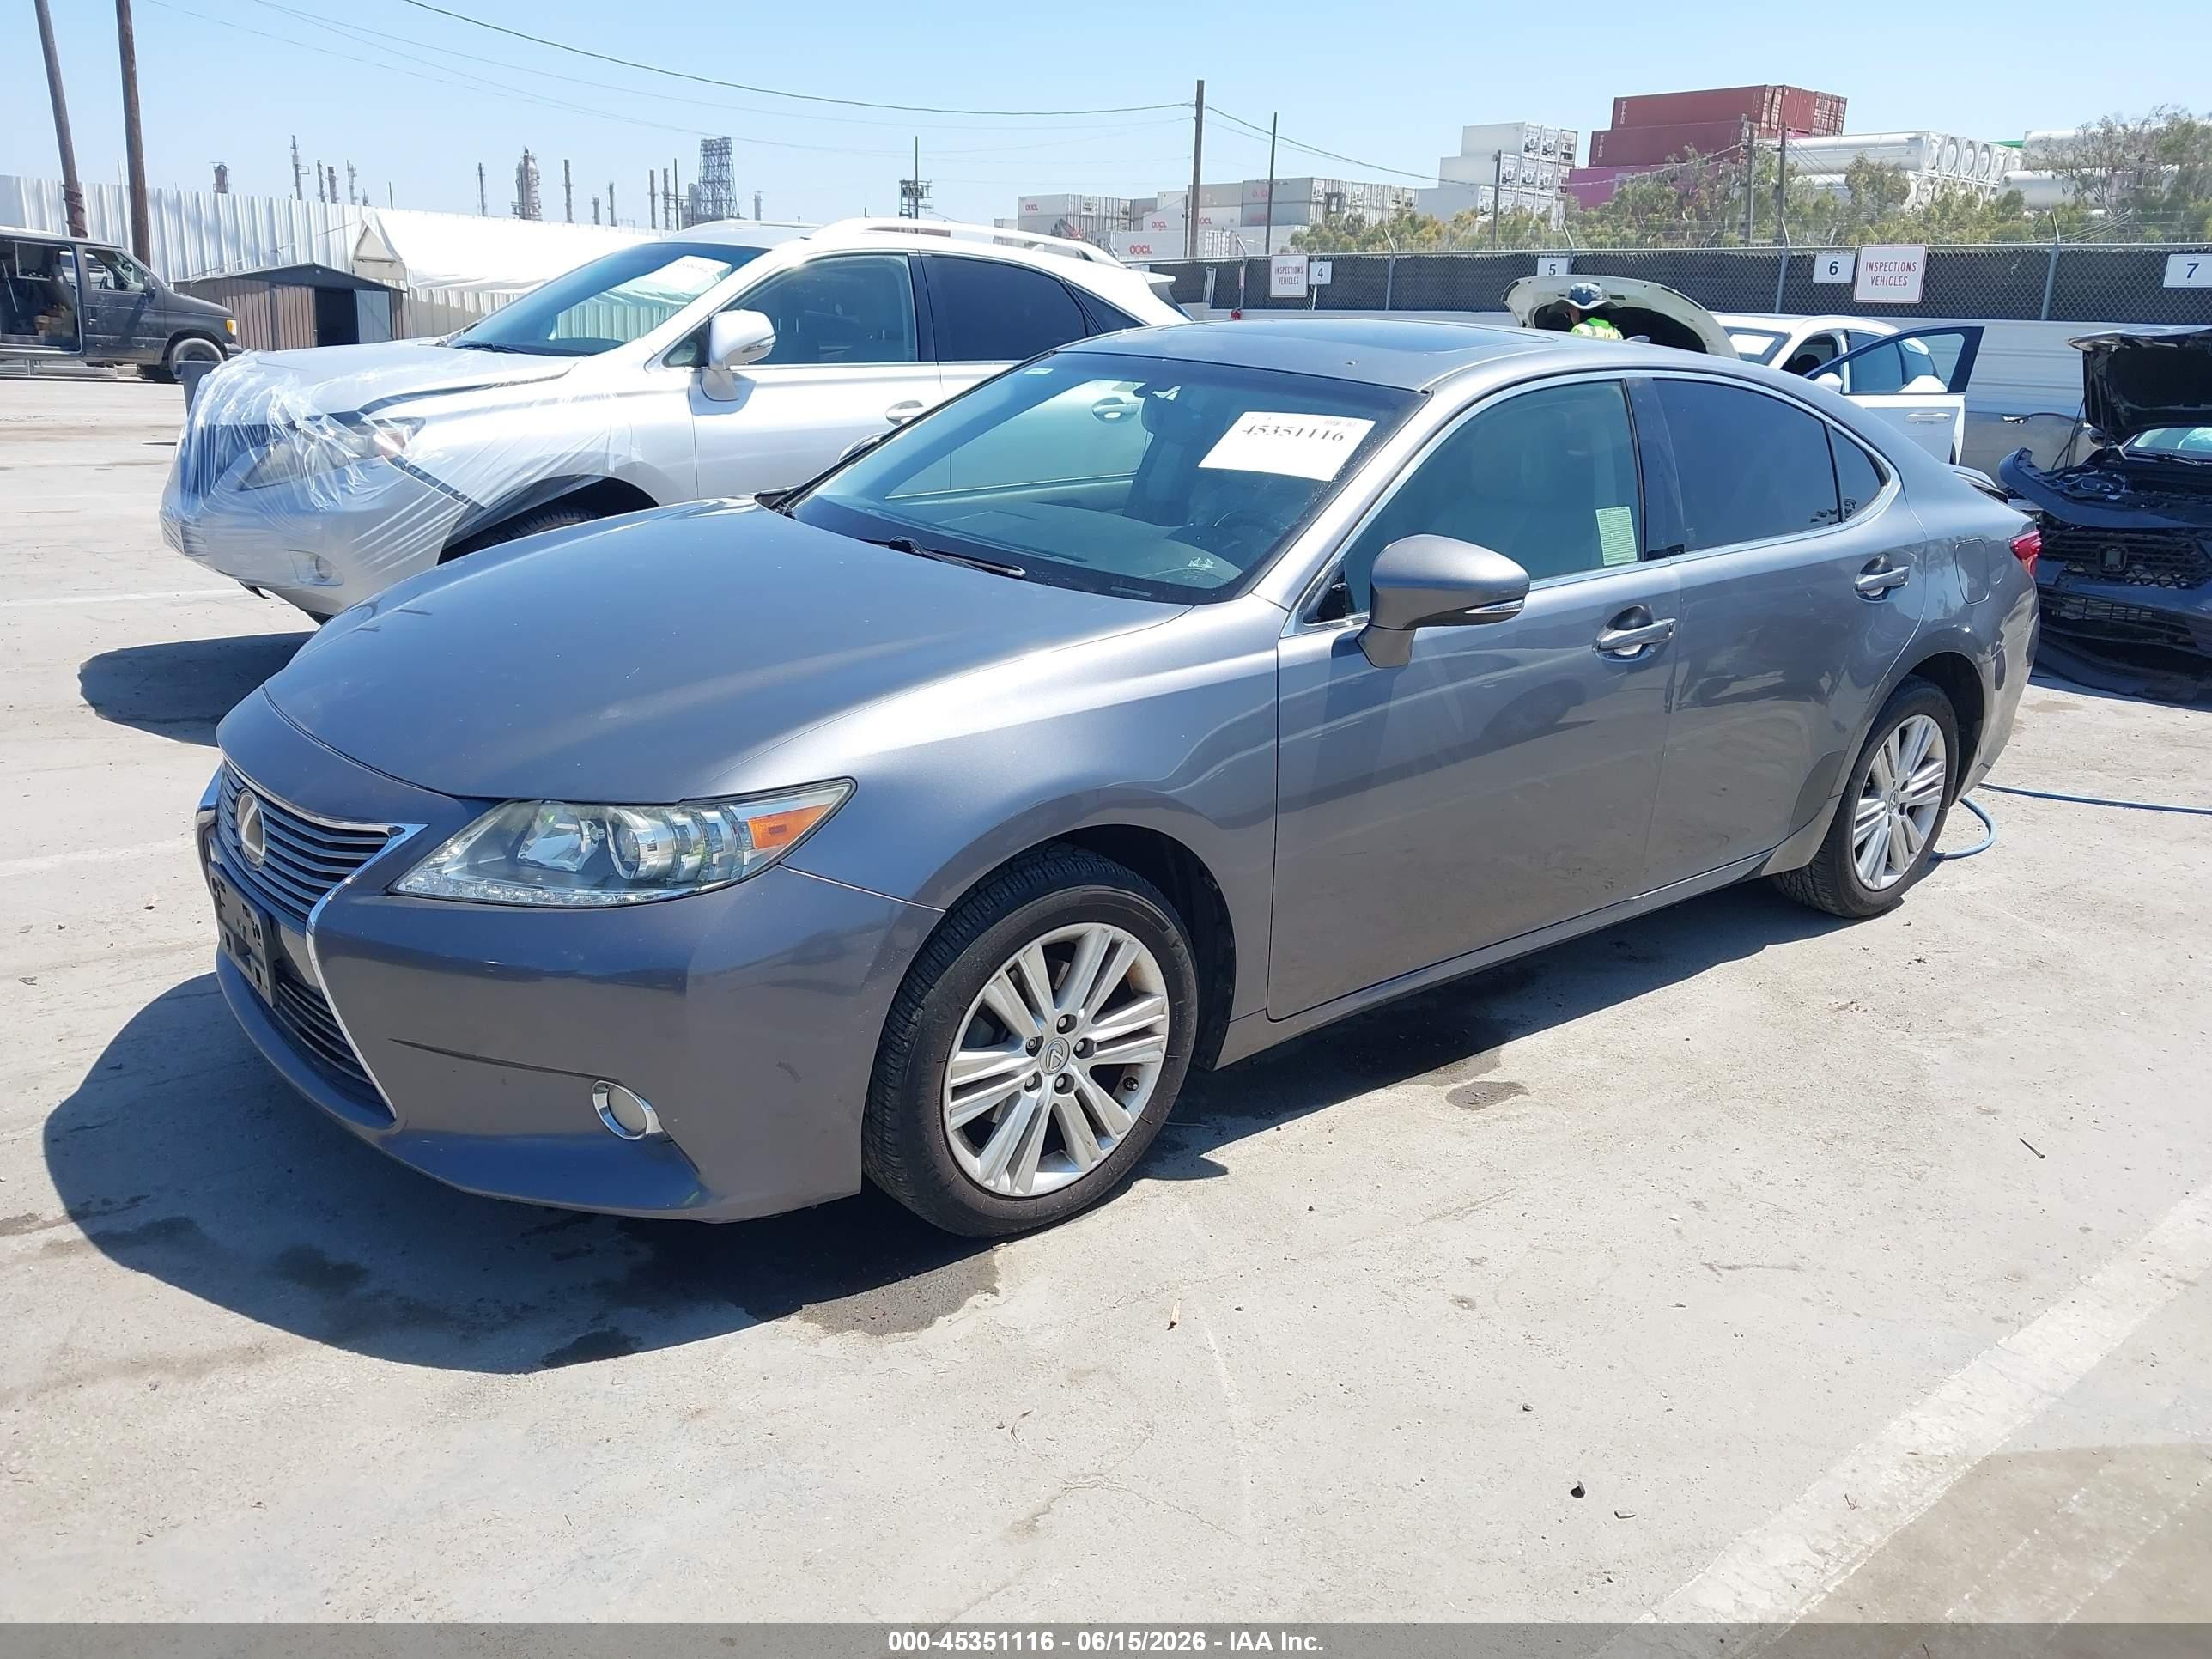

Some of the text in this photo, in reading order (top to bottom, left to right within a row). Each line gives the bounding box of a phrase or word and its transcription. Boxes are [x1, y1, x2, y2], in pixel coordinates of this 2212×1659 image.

[1129, 244, 1152, 255] OOCL
[1274, 266, 1304, 275] INSPECTIONS
[1548, 264, 1557, 276] 5
[1829, 261, 1839, 276] 6
[1865, 261, 1917, 272] INSPECTIONS
[2186, 263, 2200, 279] 7
[1317, 267, 1324, 279] 4
[1278, 276, 1299, 285] VEHICLES
[1870, 276, 1908, 286] VEHICLES
[1243, 425, 1345, 441] 45351116
